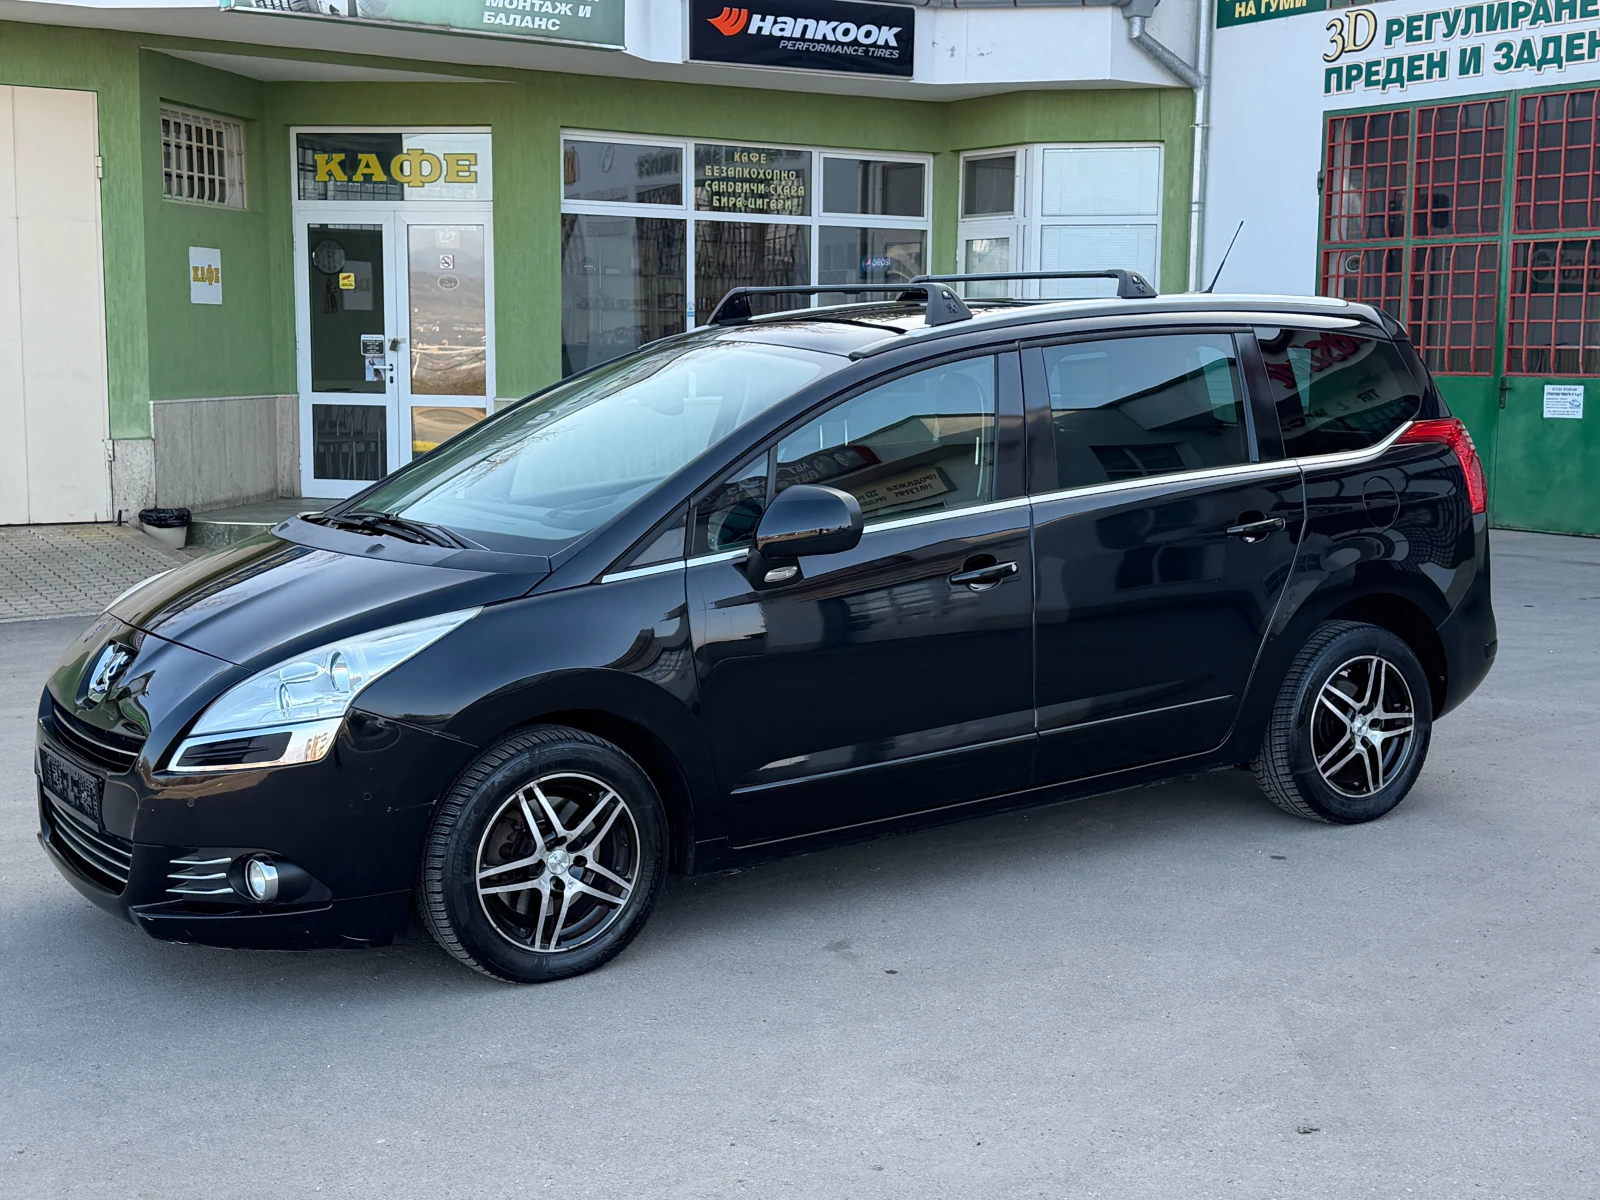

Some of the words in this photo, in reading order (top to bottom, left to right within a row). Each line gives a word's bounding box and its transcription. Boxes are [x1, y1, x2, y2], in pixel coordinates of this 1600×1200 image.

[578, 5, 592, 18] И
[1234, 0, 1256, 18] НА
[482, 11, 561, 31] БАЛАНС
[1322, 8, 1378, 63] 3D
[779, 40, 865, 57] PERFORMANCE
[868, 48, 900, 59] TIRES
[1323, 50, 1448, 95] ПРЕДЕН
[1457, 45, 1482, 77] И
[733, 151, 767, 164] КАФЕ
[313, 148, 478, 188] КАФЕ
[769, 184, 805, 197] СКАРА
[712, 195, 744, 208] БИРА
[747, 198, 793, 211] ЦИГАРИ
[871, 257, 891, 268] pepsi
[192, 264, 220, 286] КАФЕ
